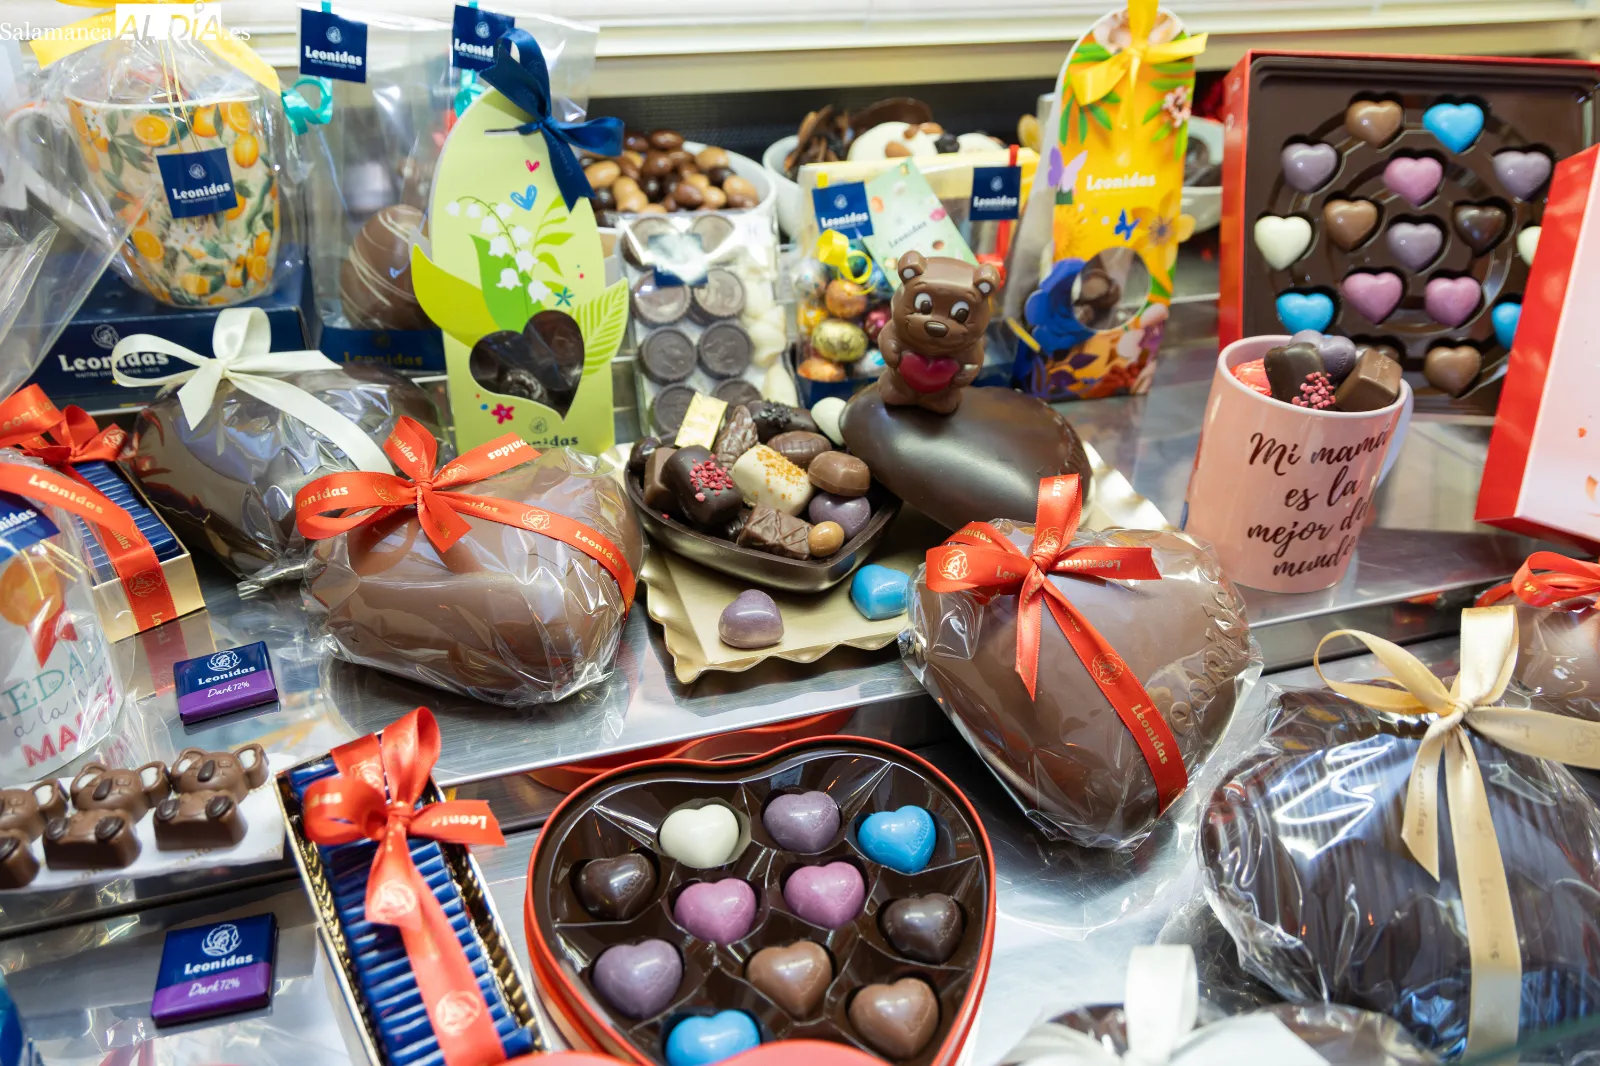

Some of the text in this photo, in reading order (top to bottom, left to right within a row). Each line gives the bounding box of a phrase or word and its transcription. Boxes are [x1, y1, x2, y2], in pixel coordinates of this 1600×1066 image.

[305, 45, 363, 66] Leonidas
[454, 38, 494, 58] Leonid
[172, 182, 231, 200] Leonidas
[1086, 173, 1156, 191] Leonidas
[973, 195, 1018, 208] Leonidas
[821, 212, 869, 228] Leonidas
[1249, 432, 1301, 476] Mi
[28, 474, 105, 515] Leonidas
[1284, 465, 1364, 511] es la
[1247, 521, 1334, 558] mejor
[198, 666, 256, 685] Leonidas
[207, 681, 250, 698] Dark 72%
[1131, 703, 1169, 765] Leonidas
[184, 954, 253, 975] Leonidas
[188, 980, 220, 997] Dark
